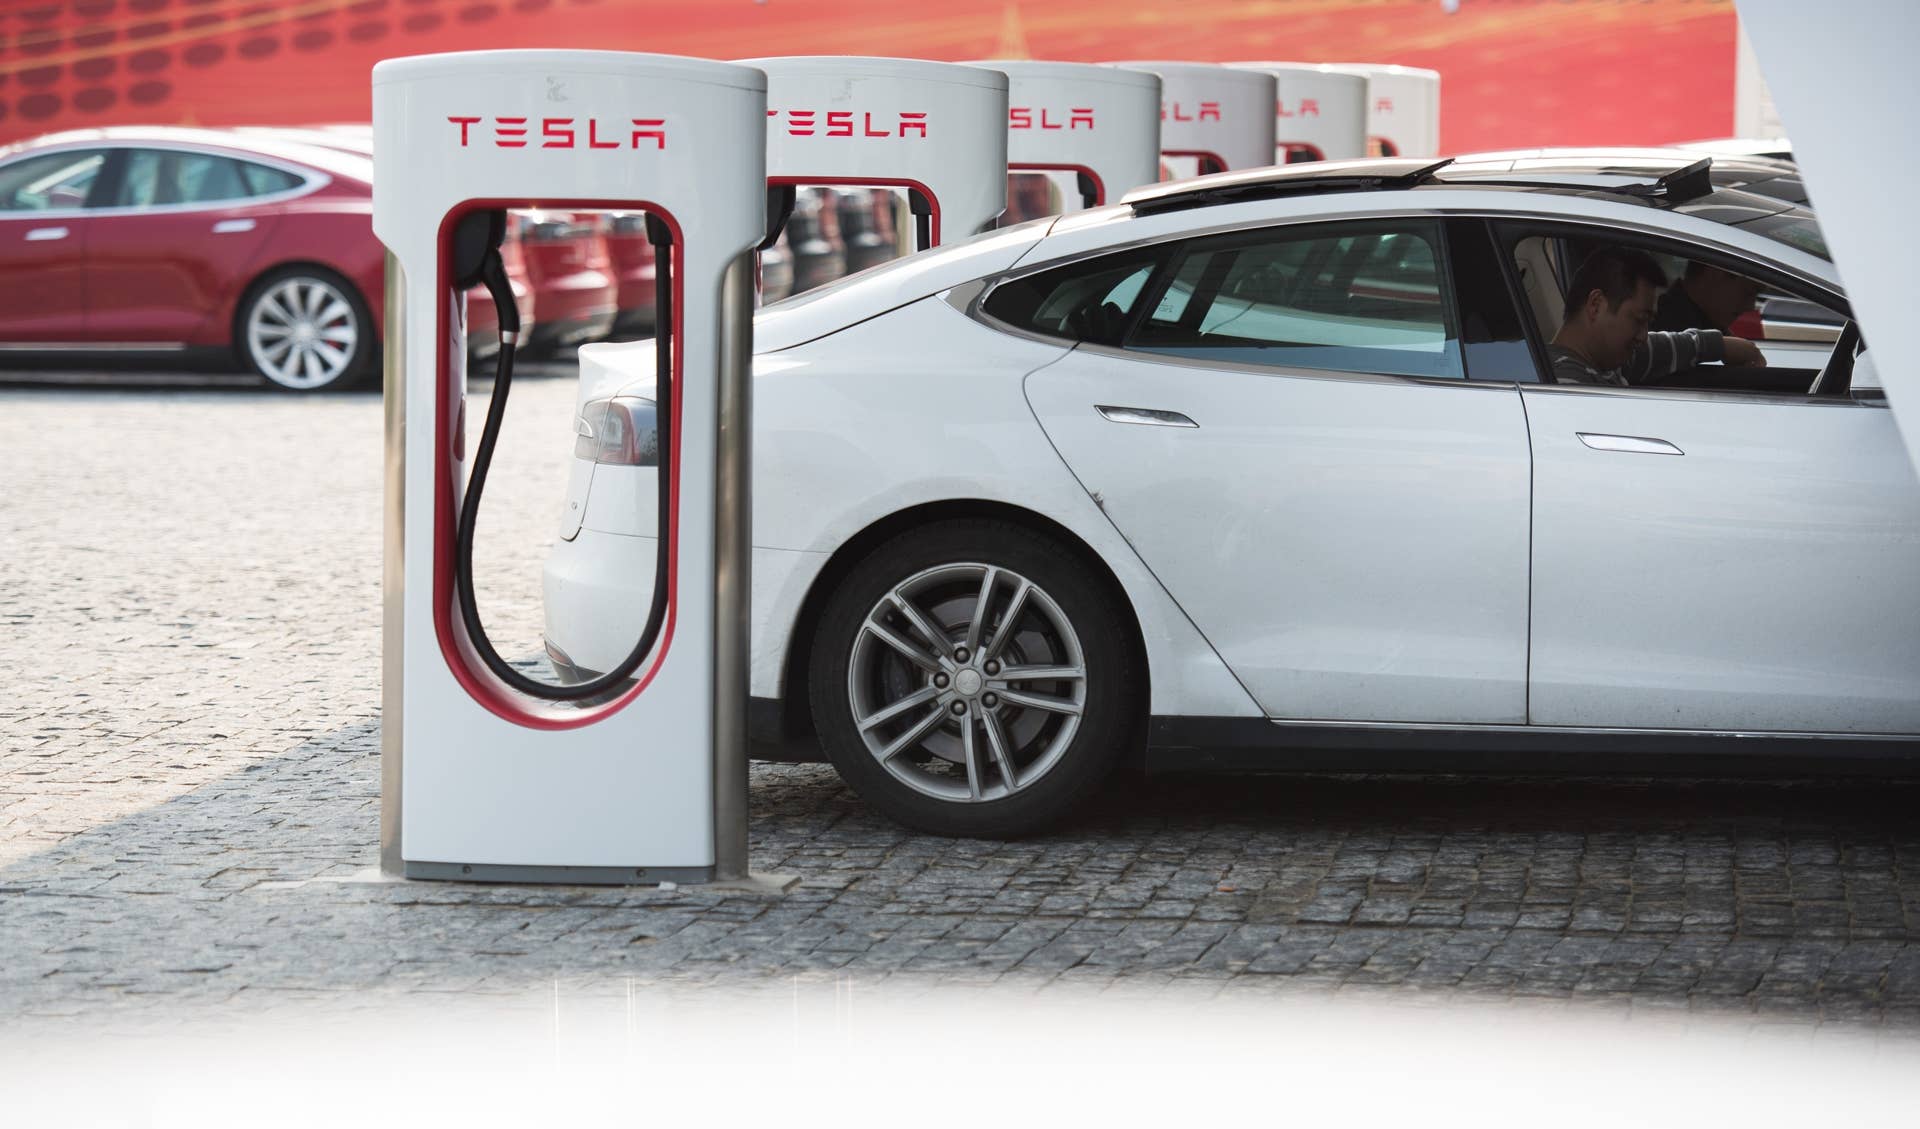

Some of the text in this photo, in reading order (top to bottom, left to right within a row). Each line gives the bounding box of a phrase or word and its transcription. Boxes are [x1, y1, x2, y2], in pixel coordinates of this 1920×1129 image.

[767, 110, 927, 138] ESLA
[1008, 107, 1094, 130] SLA
[447, 116, 666, 150] TESLA
